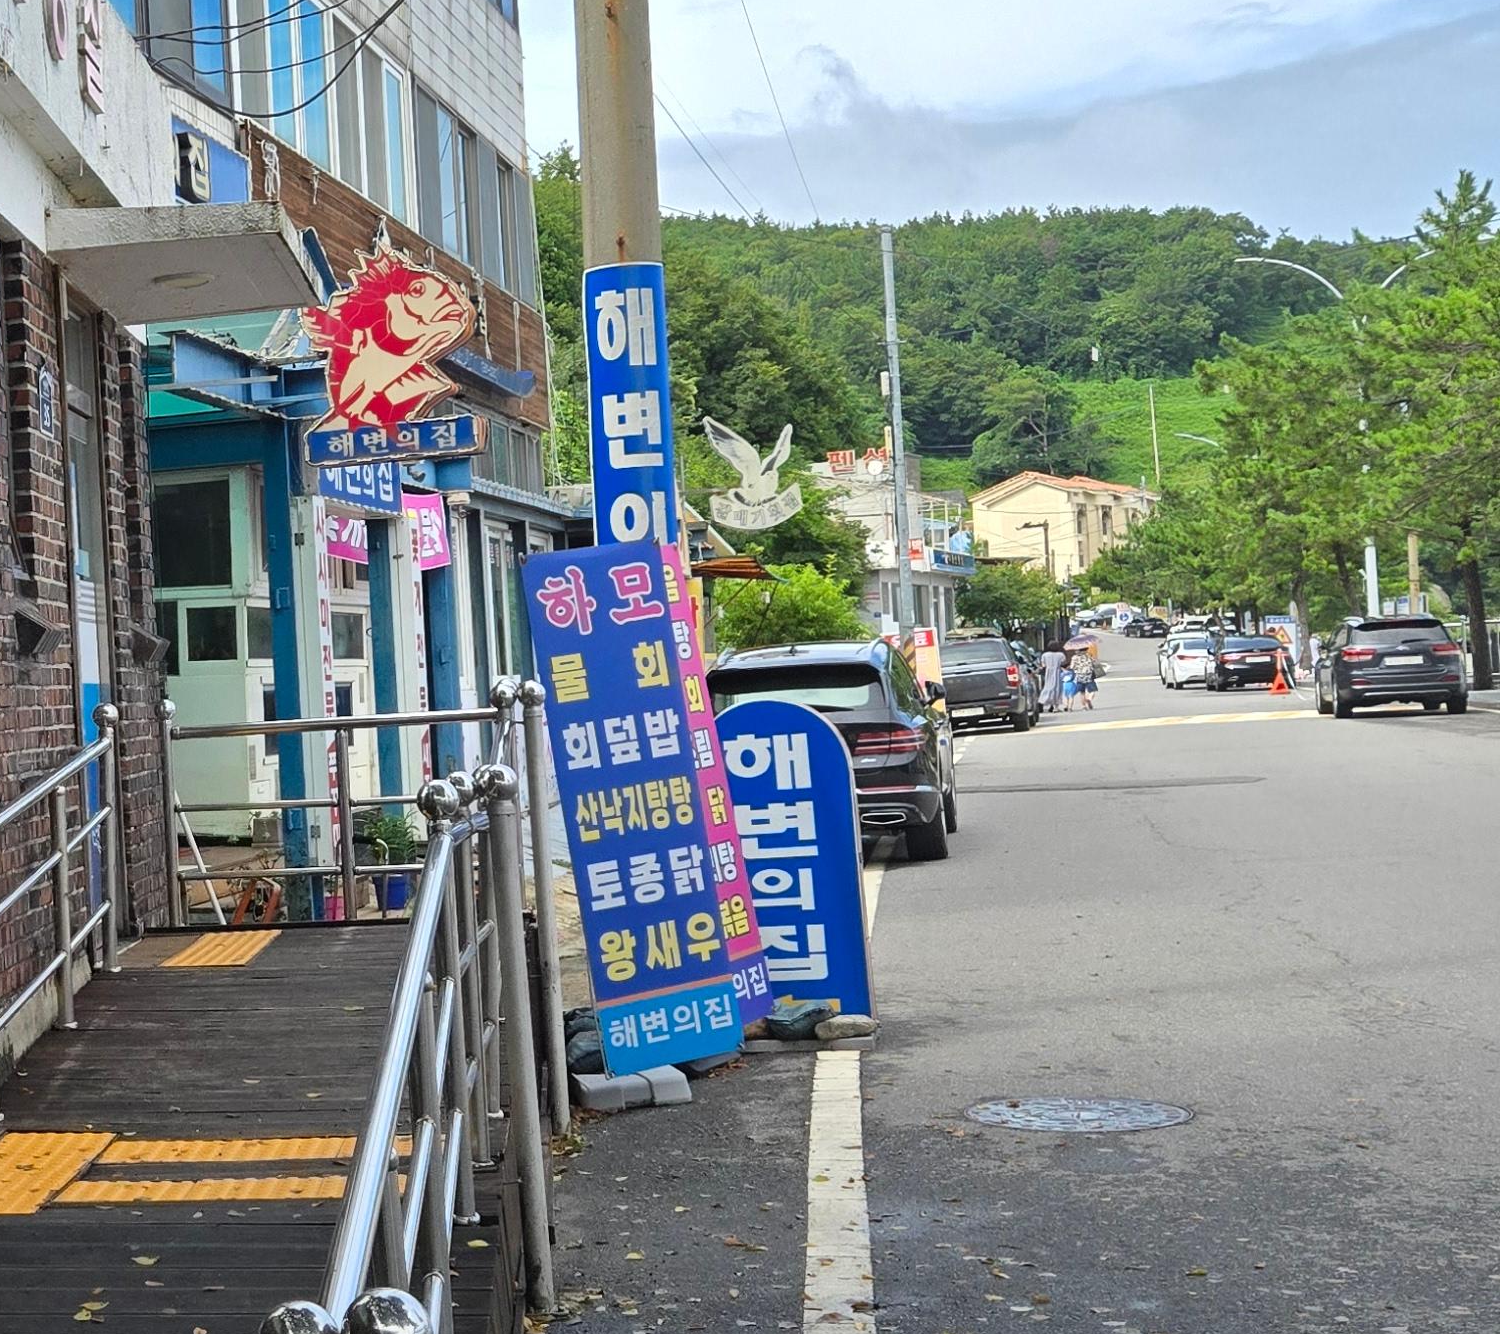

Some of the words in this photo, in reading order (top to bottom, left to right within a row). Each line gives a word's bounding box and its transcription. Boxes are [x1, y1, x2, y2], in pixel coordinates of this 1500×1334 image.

[327, 422, 457, 457] 해변의집
[562, 708, 681, 771] 회덮밥
[575, 776, 694, 843] 산낙지탕탕
[587, 844, 705, 912] 토종닭
[722, 732, 829, 982] 해변의집
[599, 912, 722, 983] 왕새우
[608, 994, 734, 1049] 해변의집
